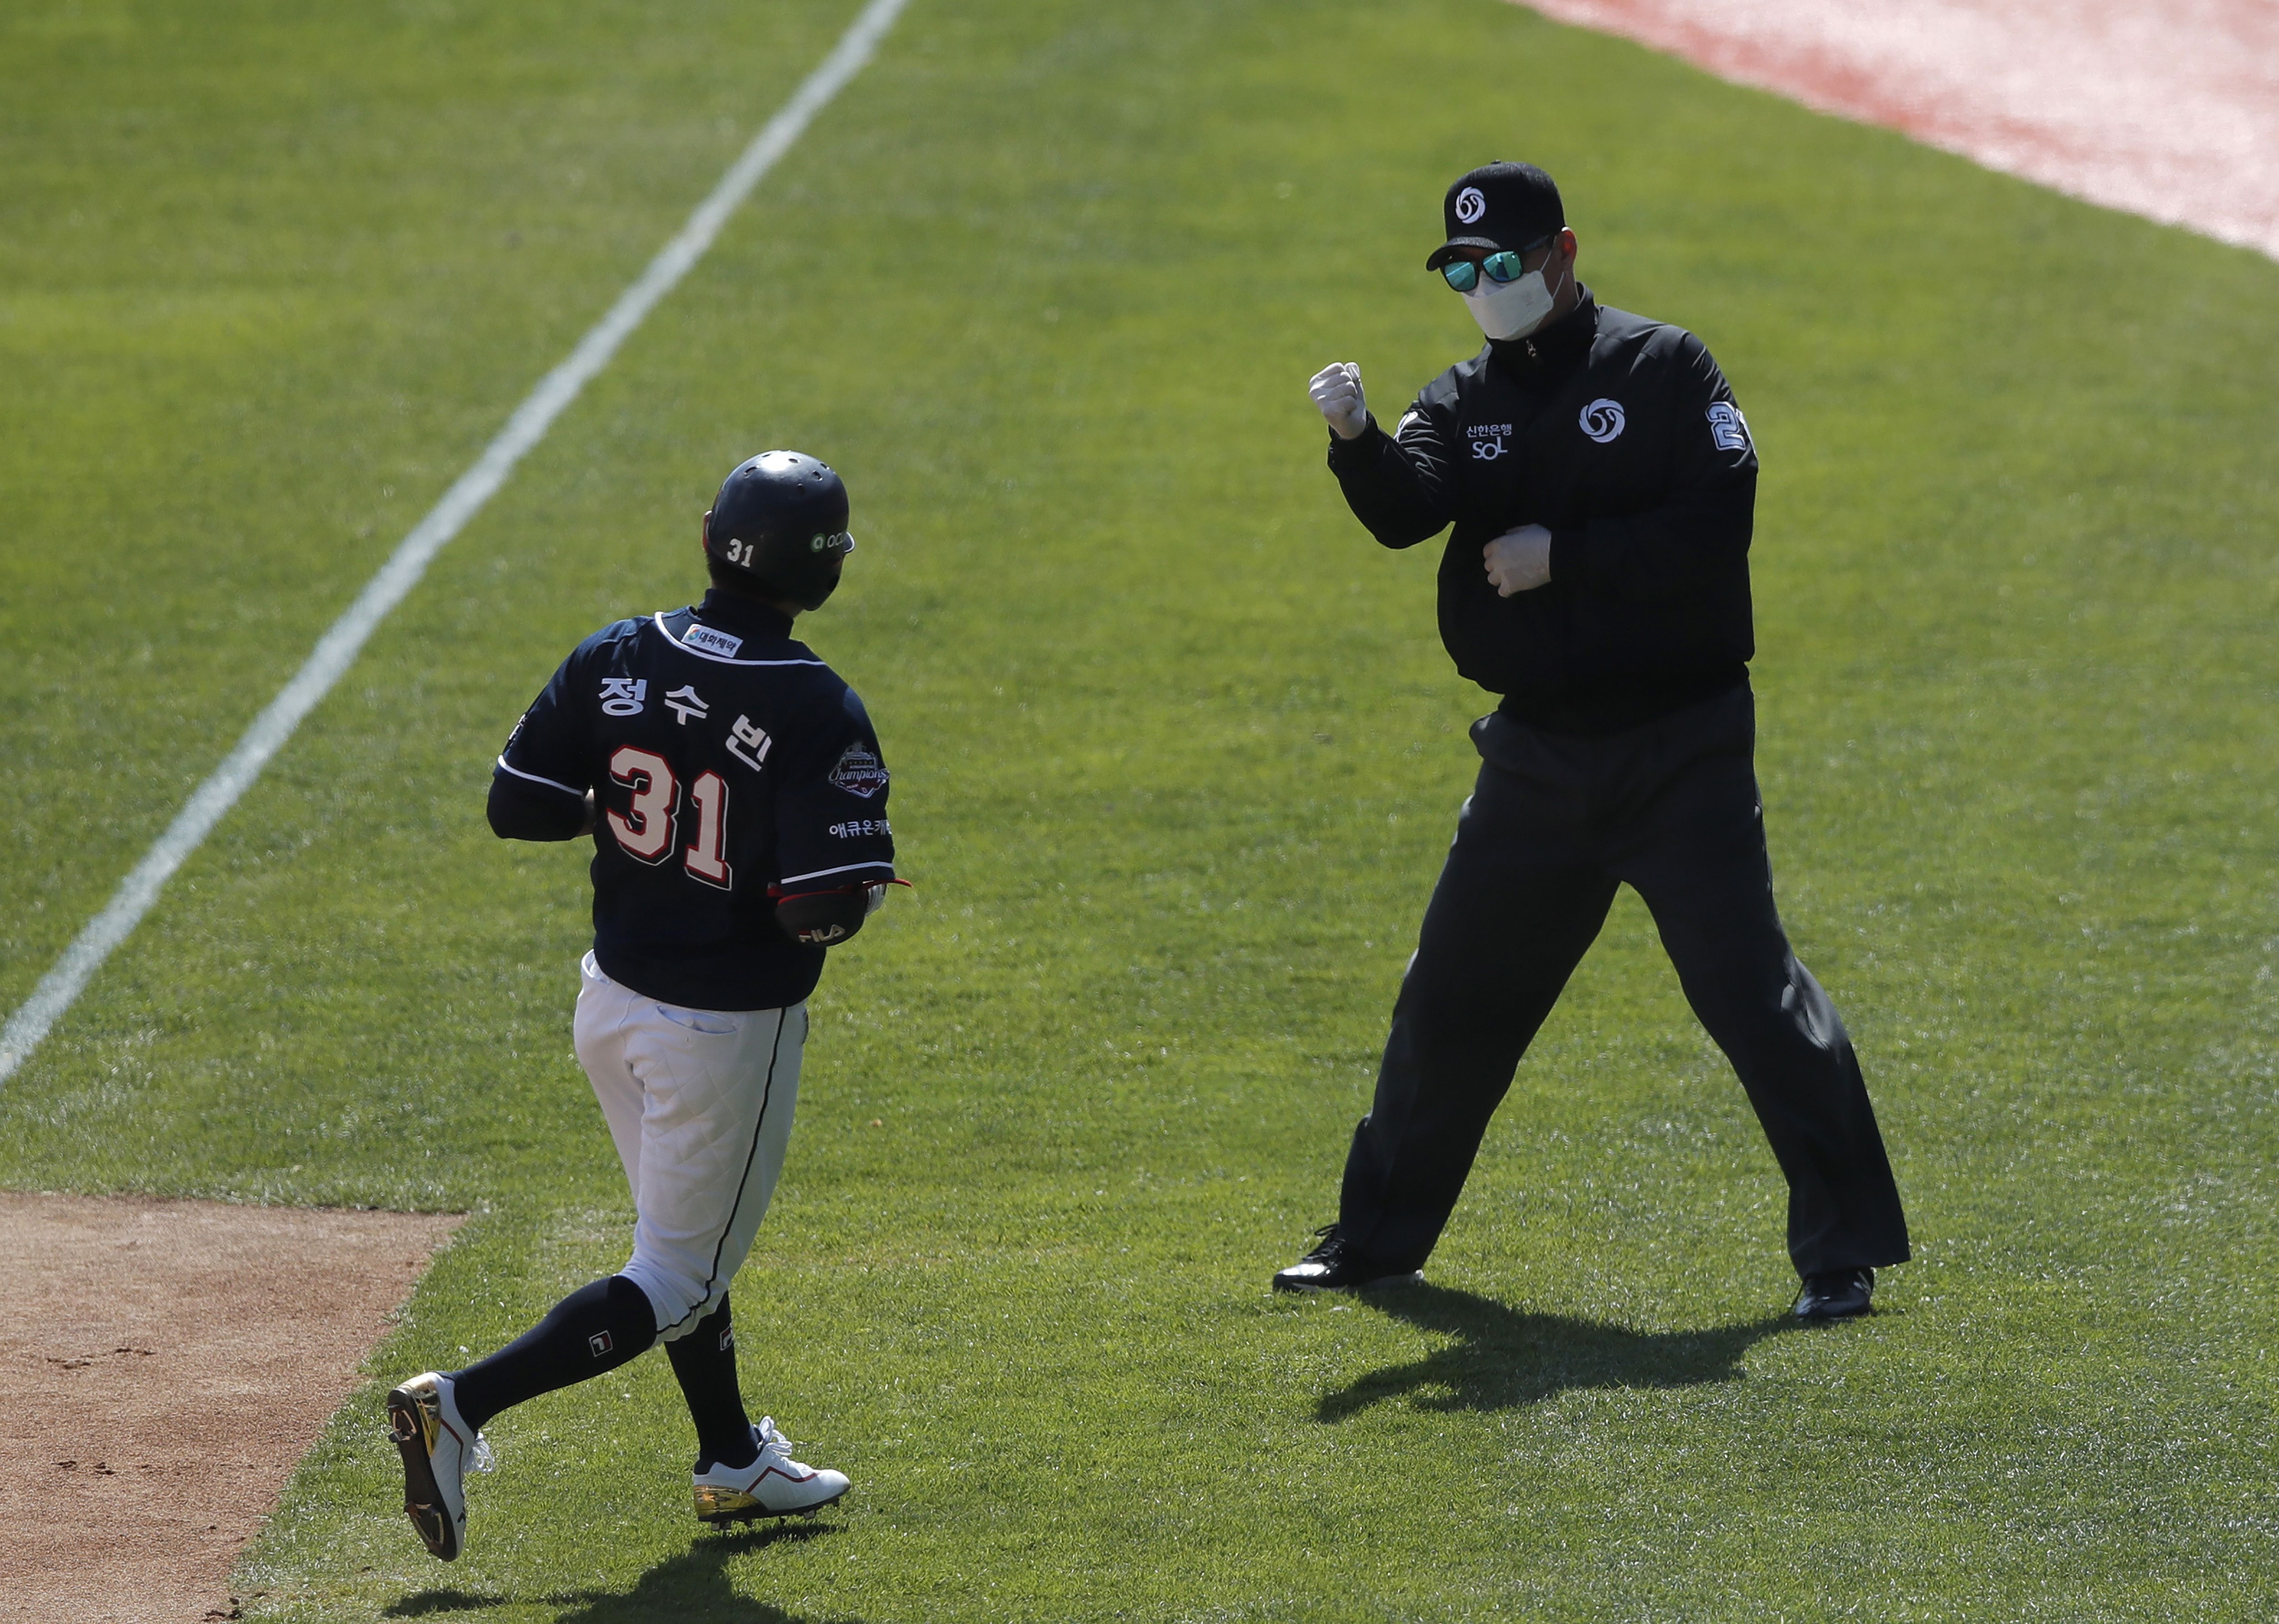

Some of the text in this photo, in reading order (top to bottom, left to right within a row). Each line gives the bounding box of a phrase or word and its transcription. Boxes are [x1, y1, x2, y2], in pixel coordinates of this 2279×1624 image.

[1466, 423, 1512, 438] 신한은행
[1705, 402, 1754, 452] 2
[727, 538, 754, 567] 31
[699, 632, 737, 652] 대화제약
[598, 677, 772, 772] 정수빈
[606, 744, 732, 892] 31
